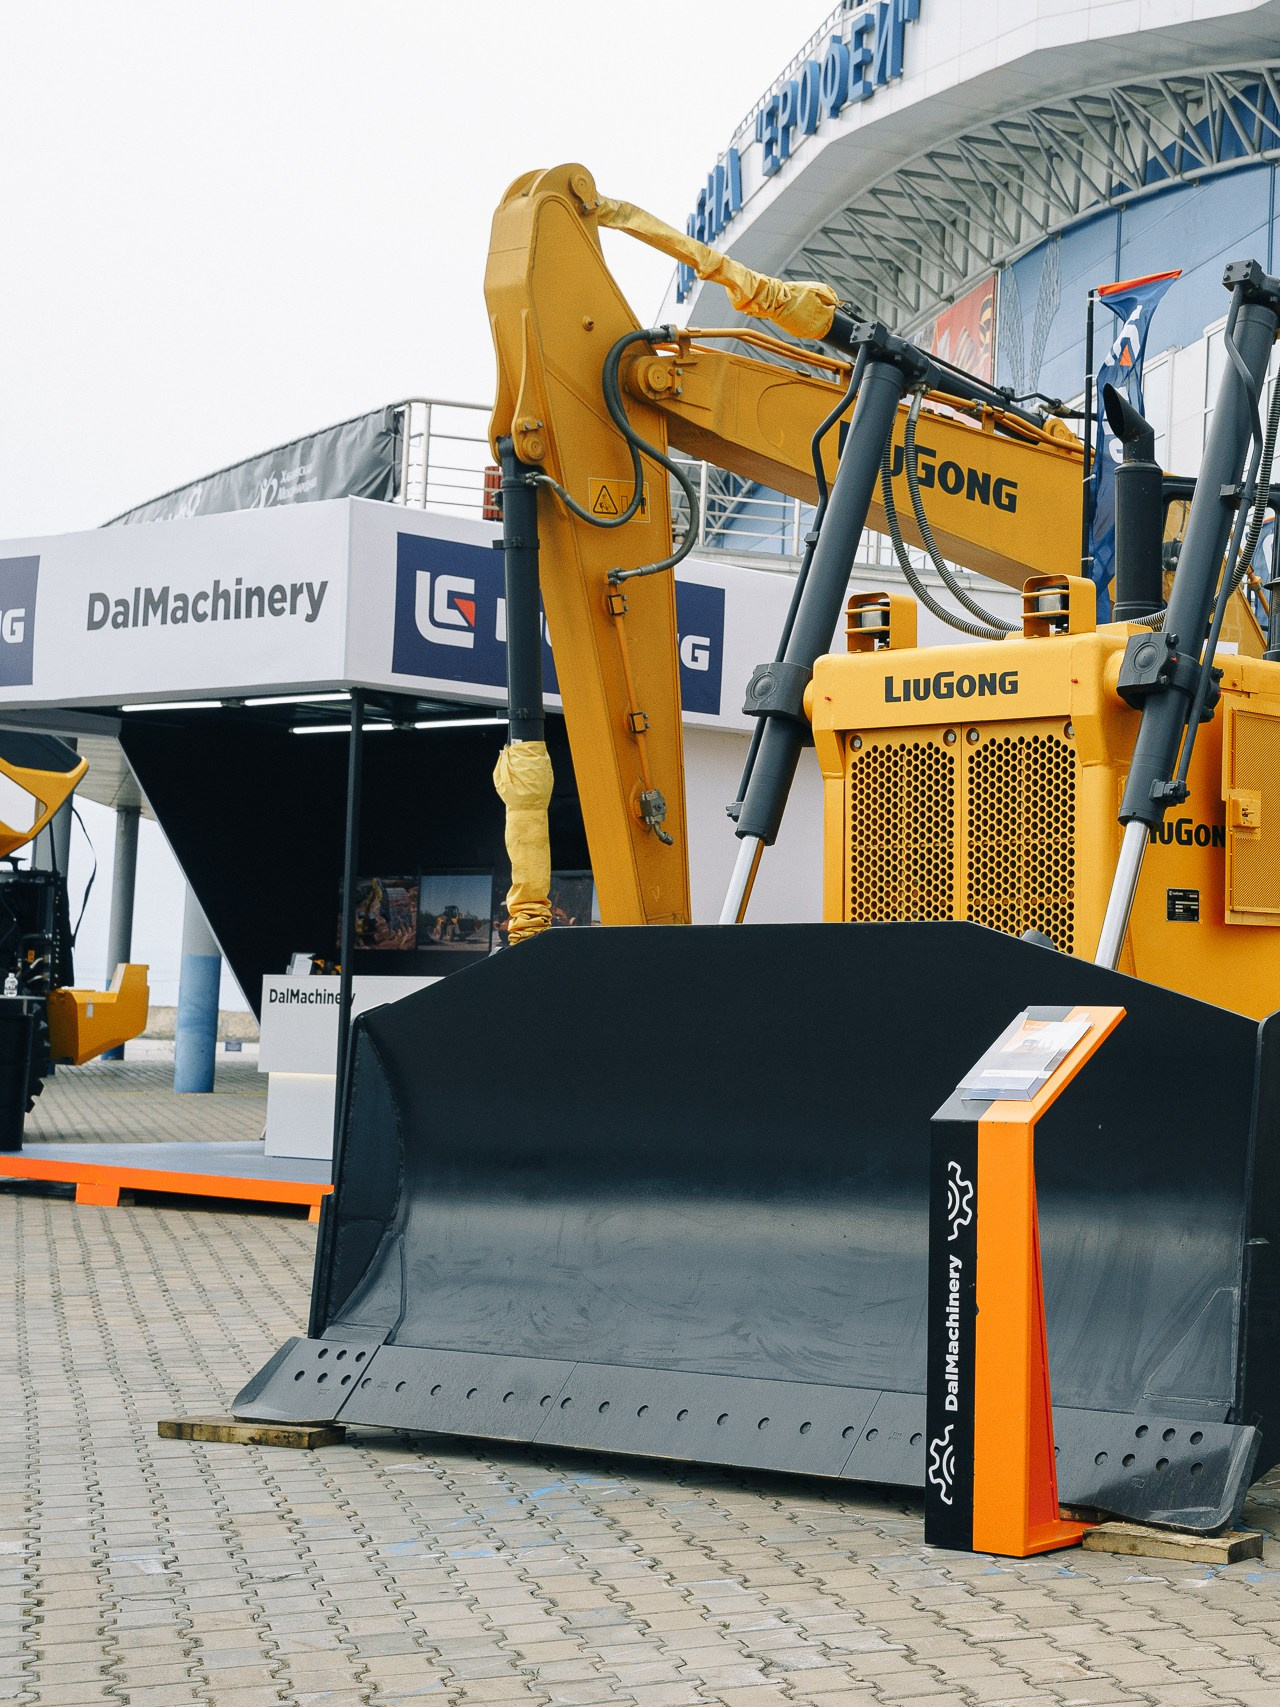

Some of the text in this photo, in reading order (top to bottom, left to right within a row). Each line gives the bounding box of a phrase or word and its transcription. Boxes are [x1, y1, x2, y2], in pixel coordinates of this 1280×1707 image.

[87, 577, 329, 631] DalMachinery
[268, 988, 356, 1008] DalMachiney
[944, 1254, 963, 1412] DalMachinery
